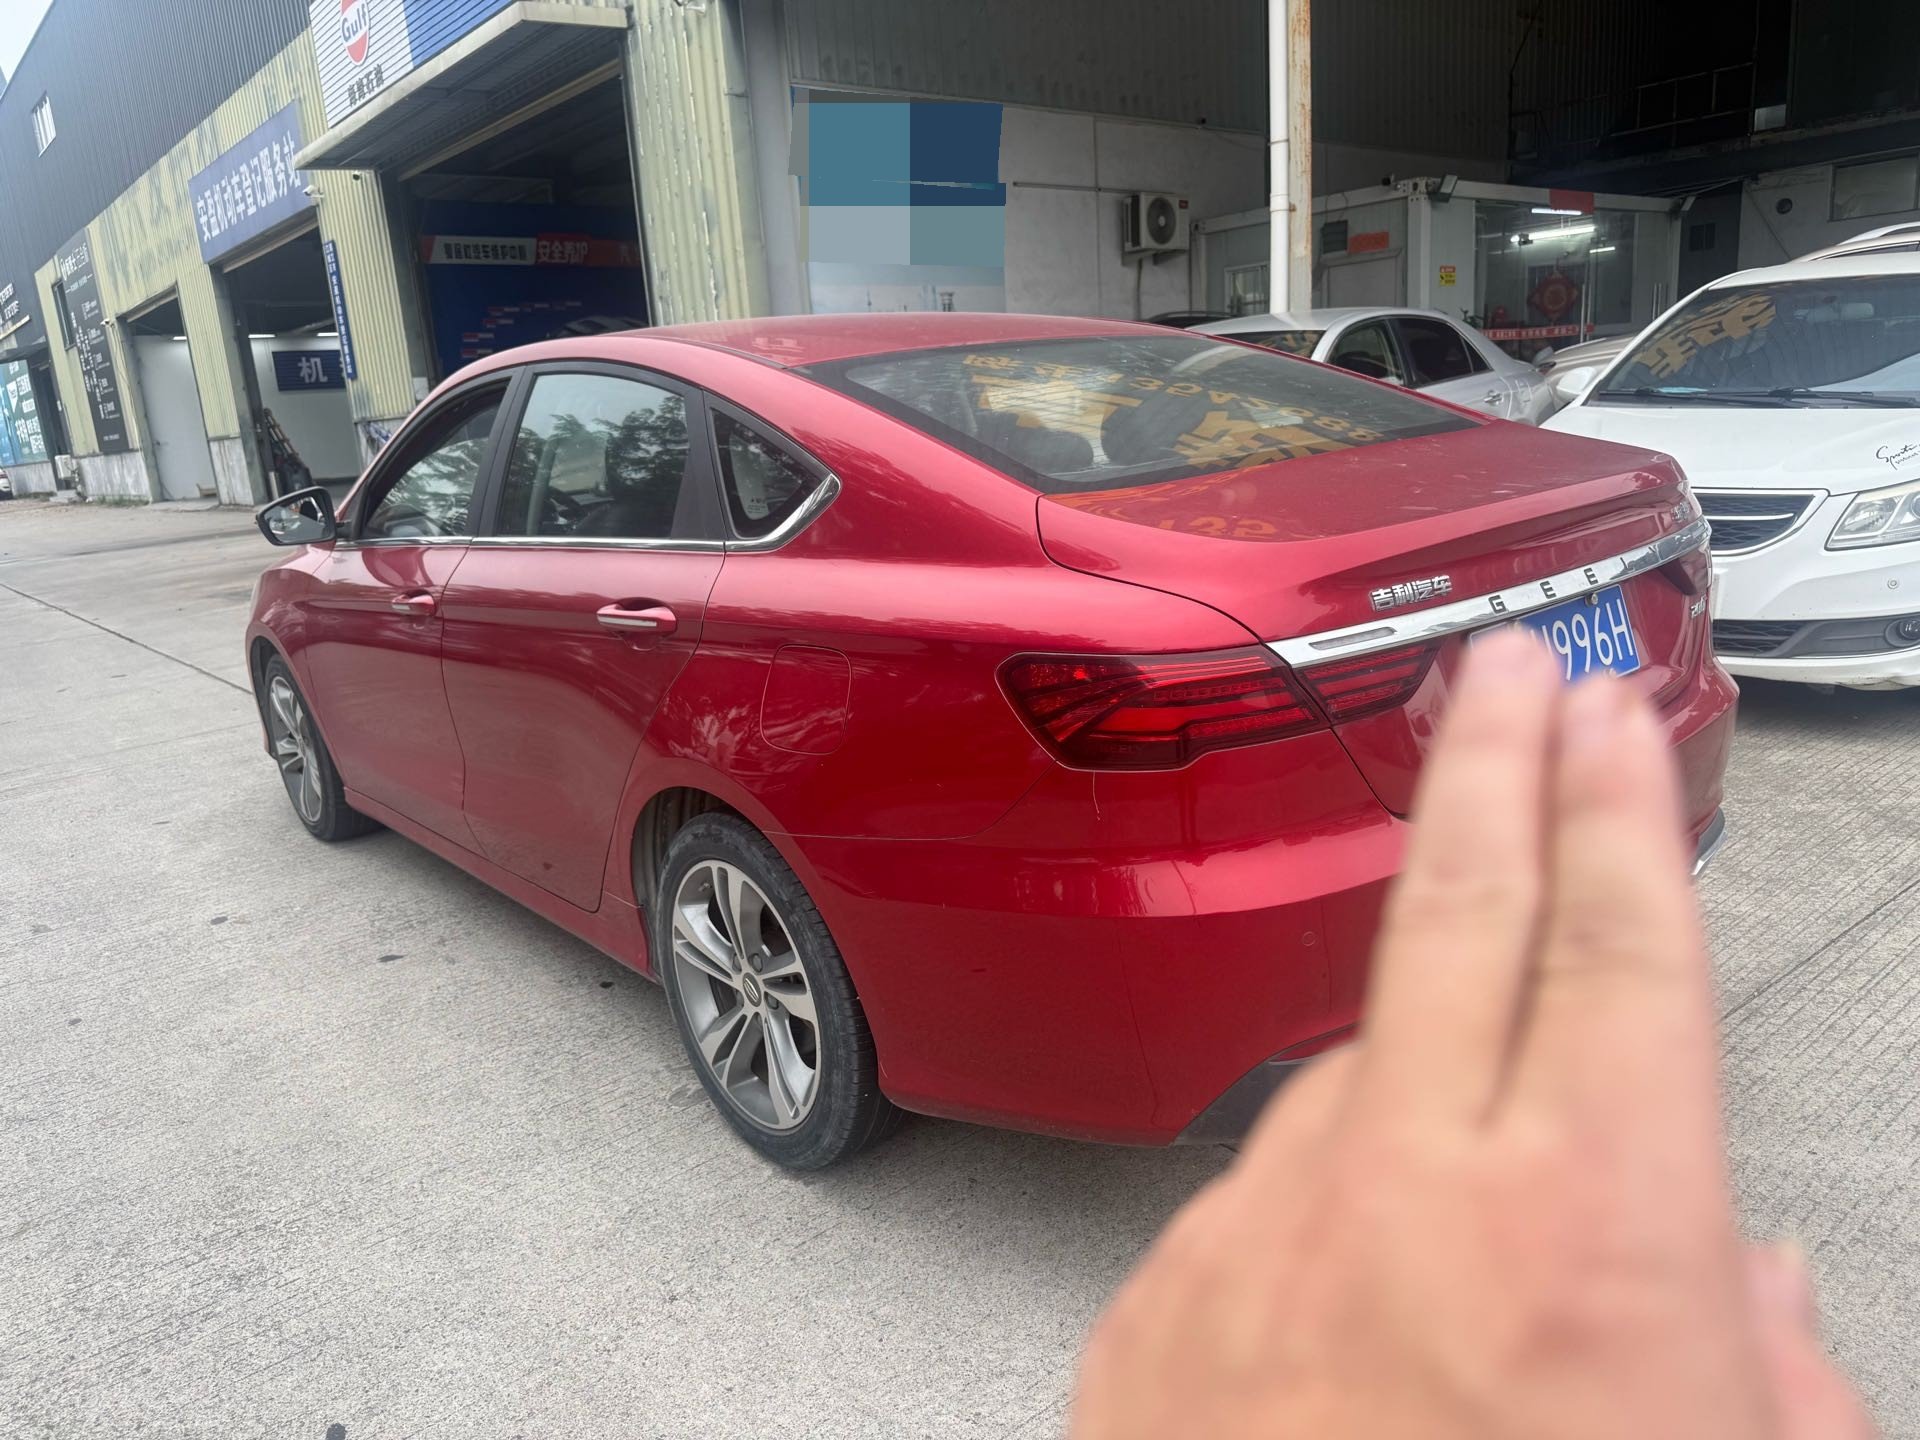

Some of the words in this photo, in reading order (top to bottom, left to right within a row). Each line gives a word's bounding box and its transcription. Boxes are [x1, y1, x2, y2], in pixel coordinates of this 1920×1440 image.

[342, 3, 367, 42] Gulf
[1371, 575, 1452, 611] 吉利汽车
